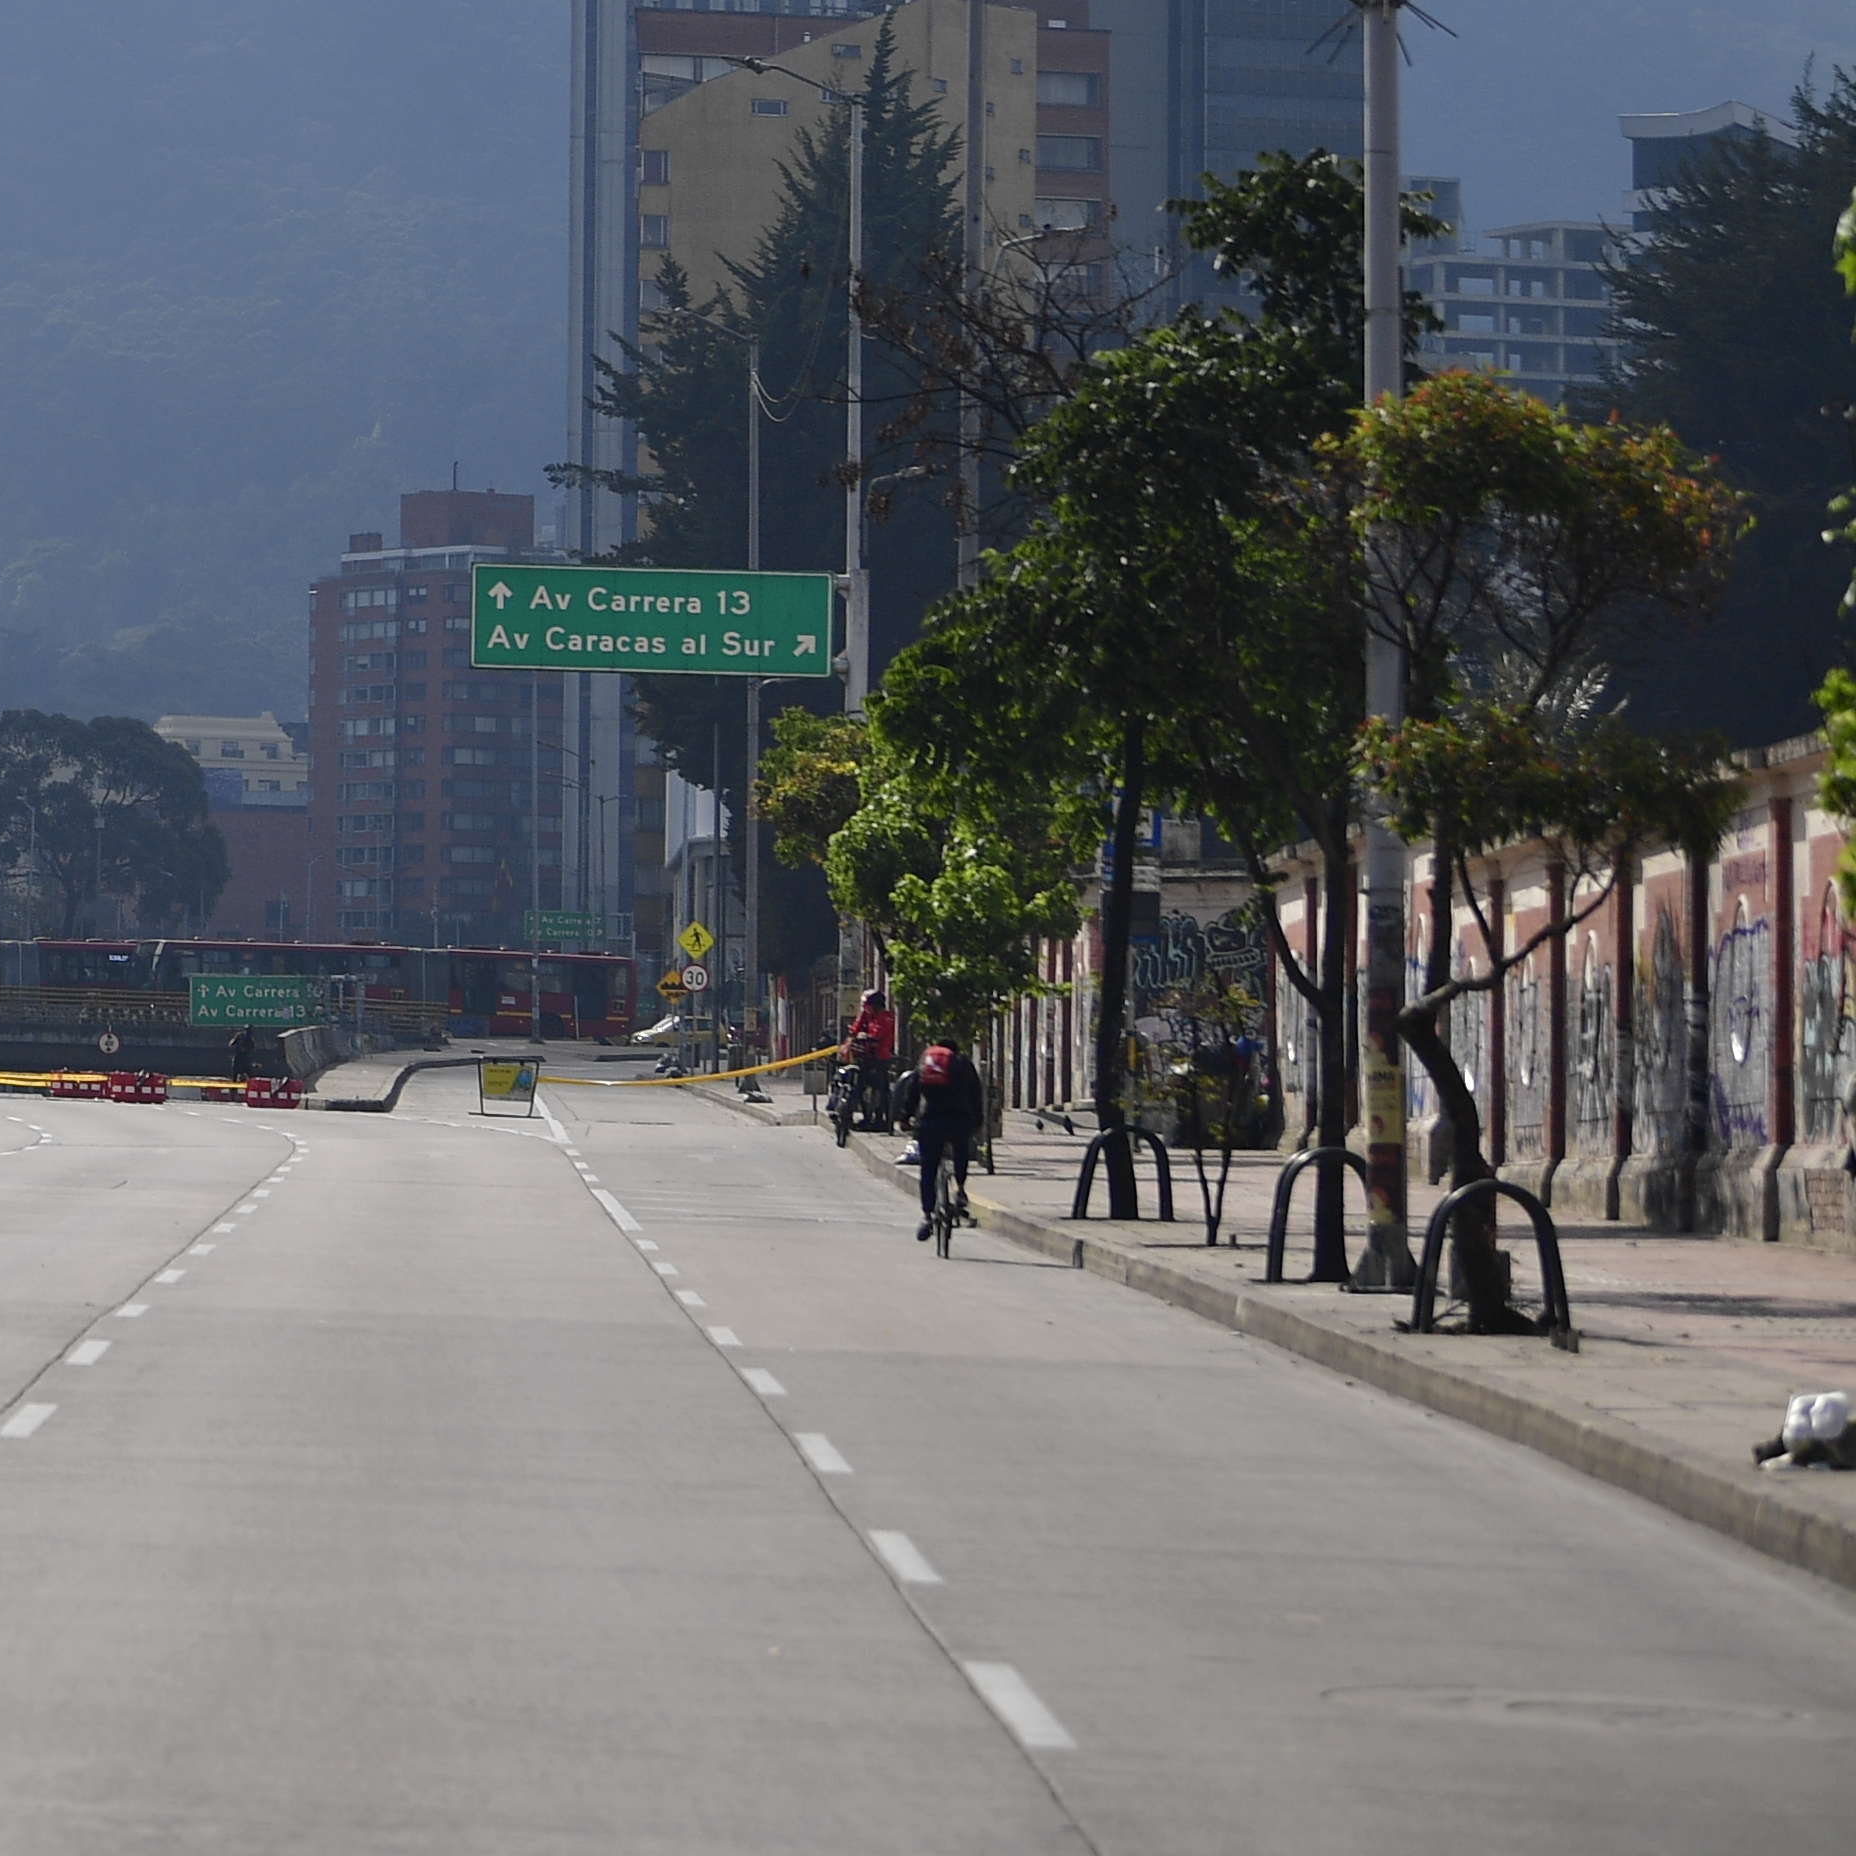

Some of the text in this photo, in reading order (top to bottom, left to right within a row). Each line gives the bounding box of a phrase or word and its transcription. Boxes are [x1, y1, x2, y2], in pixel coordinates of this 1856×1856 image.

[529, 585, 752, 616] Av Carrera 13
[486, 625, 776, 657] Av Caracas al Sur
[685, 970, 705, 986] 30
[215, 984, 237, 998] Av
[243, 985, 300, 999] Carrera
[197, 1004, 306, 1018] Av Carrera 13
